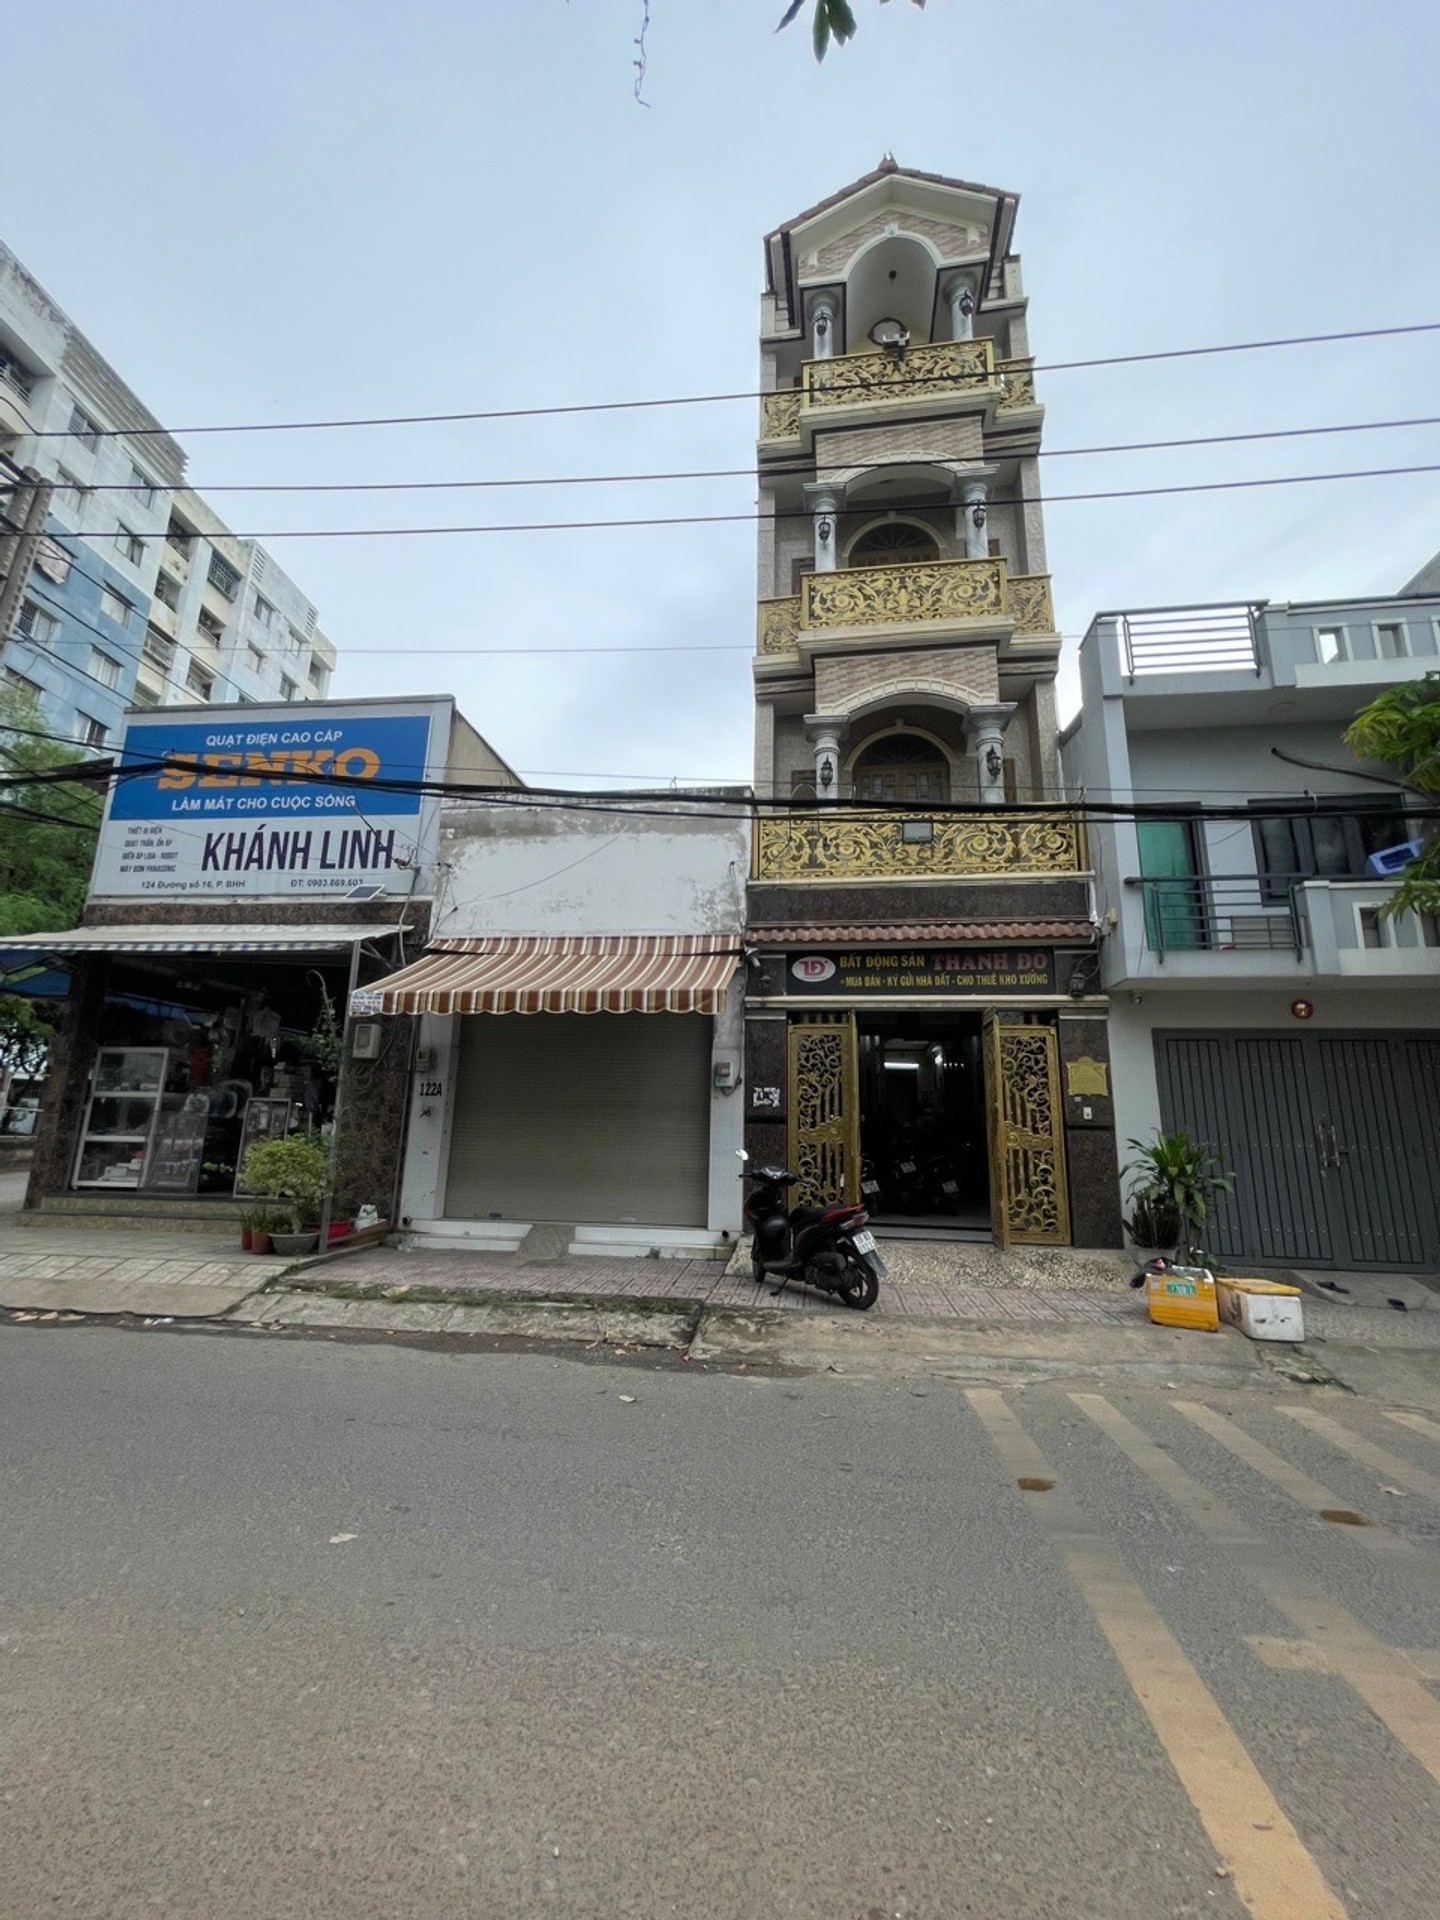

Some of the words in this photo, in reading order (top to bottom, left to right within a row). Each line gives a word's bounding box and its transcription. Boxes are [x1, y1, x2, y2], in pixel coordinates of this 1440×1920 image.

[206, 733, 241, 748] QUẠT
[246, 731, 277, 745] ĐIỆN
[281, 731, 310, 743] CAO
[314, 729, 343, 742] CẤP
[158, 747, 380, 790] SENKO
[171, 797, 201, 811] LÀM
[204, 795, 233, 810] MÁT
[236, 797, 267, 809] CHO
[271, 797, 310, 812] CUỘC
[315, 793, 356, 808] SỐNG
[201, 824, 312, 871] KHÁNH
[320, 829, 395, 870] LINH
[142, 881, 155, 890] 124
[840, 952, 861, 968] BẤT
[956, 975, 974, 985] CHO
[999, 974, 1017, 985] KHO
[420, 1082, 442, 1096] 122A
